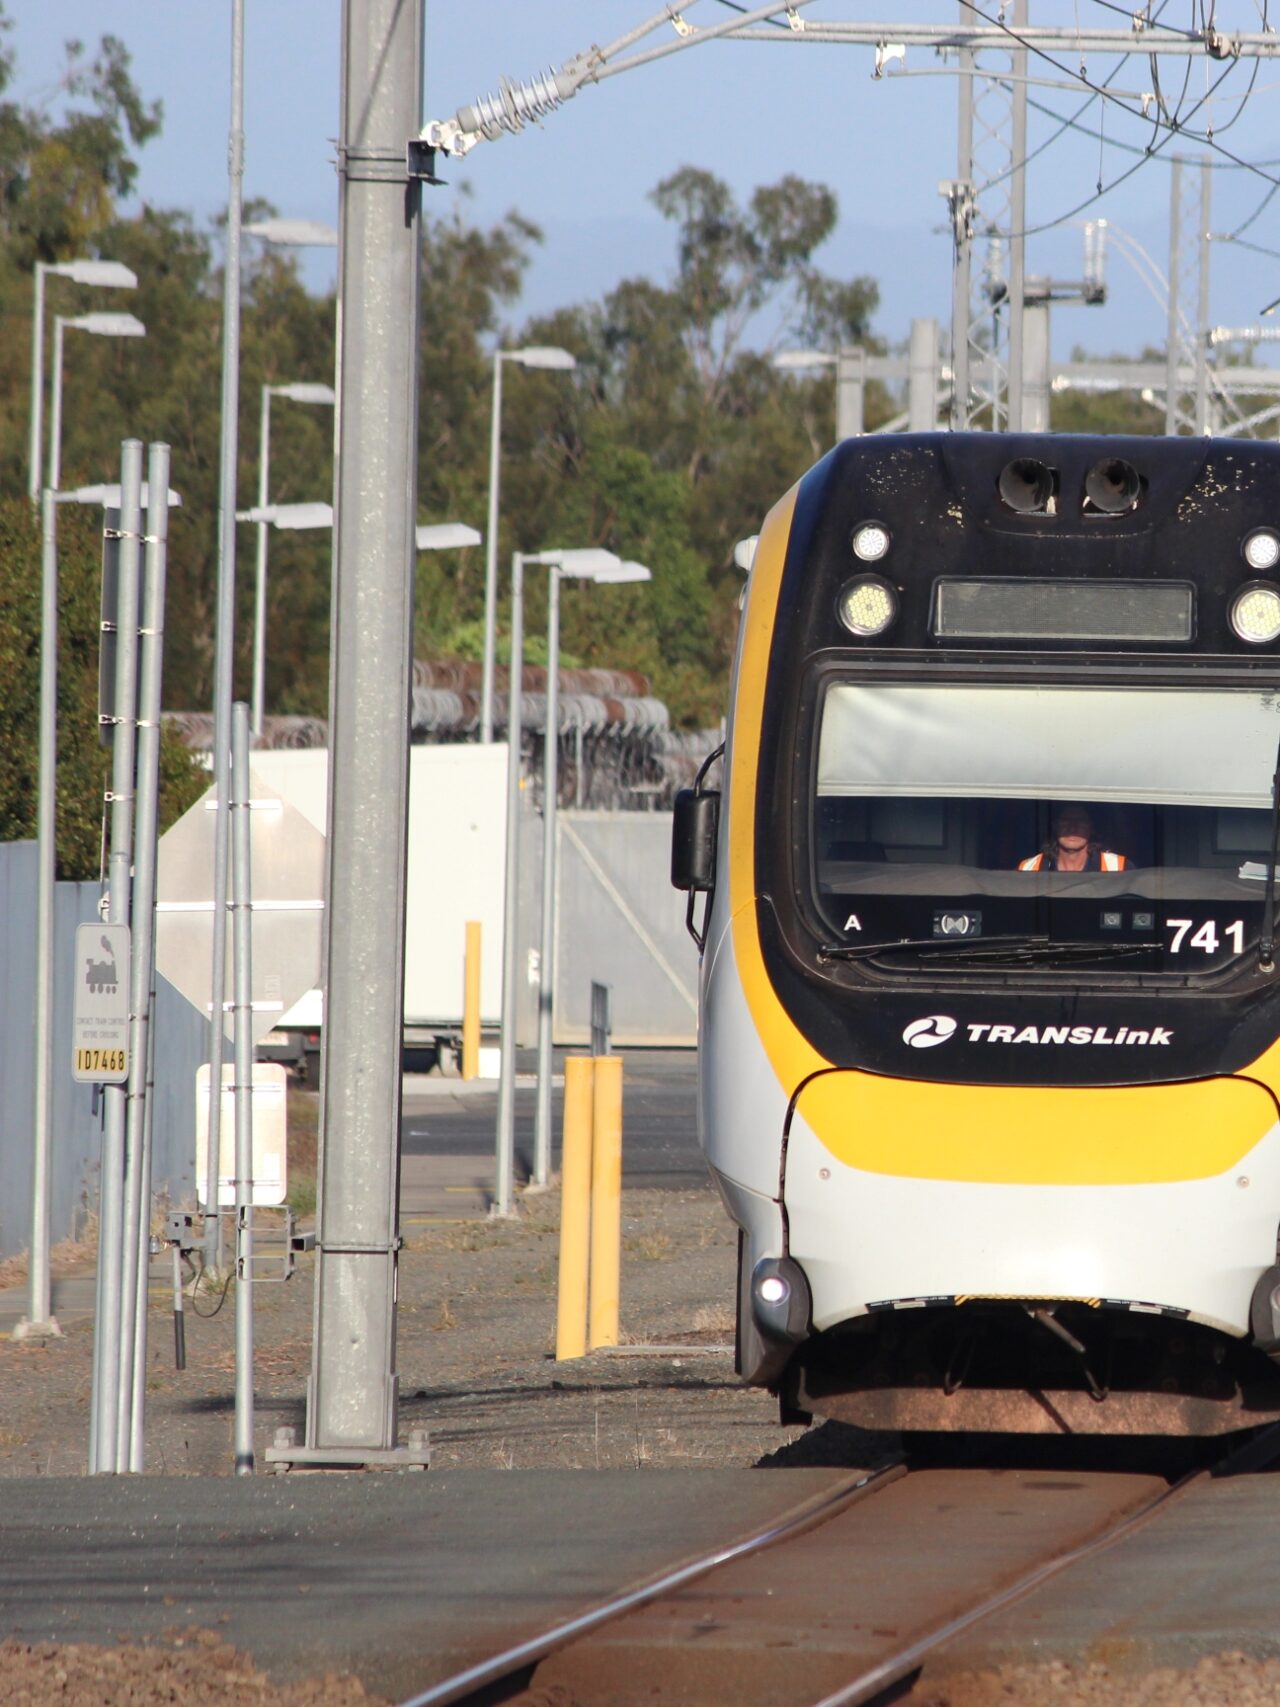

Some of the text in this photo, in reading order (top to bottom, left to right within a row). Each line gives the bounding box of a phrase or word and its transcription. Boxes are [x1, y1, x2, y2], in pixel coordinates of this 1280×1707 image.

[843, 914, 862, 931] A
[1166, 919, 1244, 954] 741
[967, 1024, 1174, 1045] TRANSLink
[78, 1049, 125, 1071] ID7468
